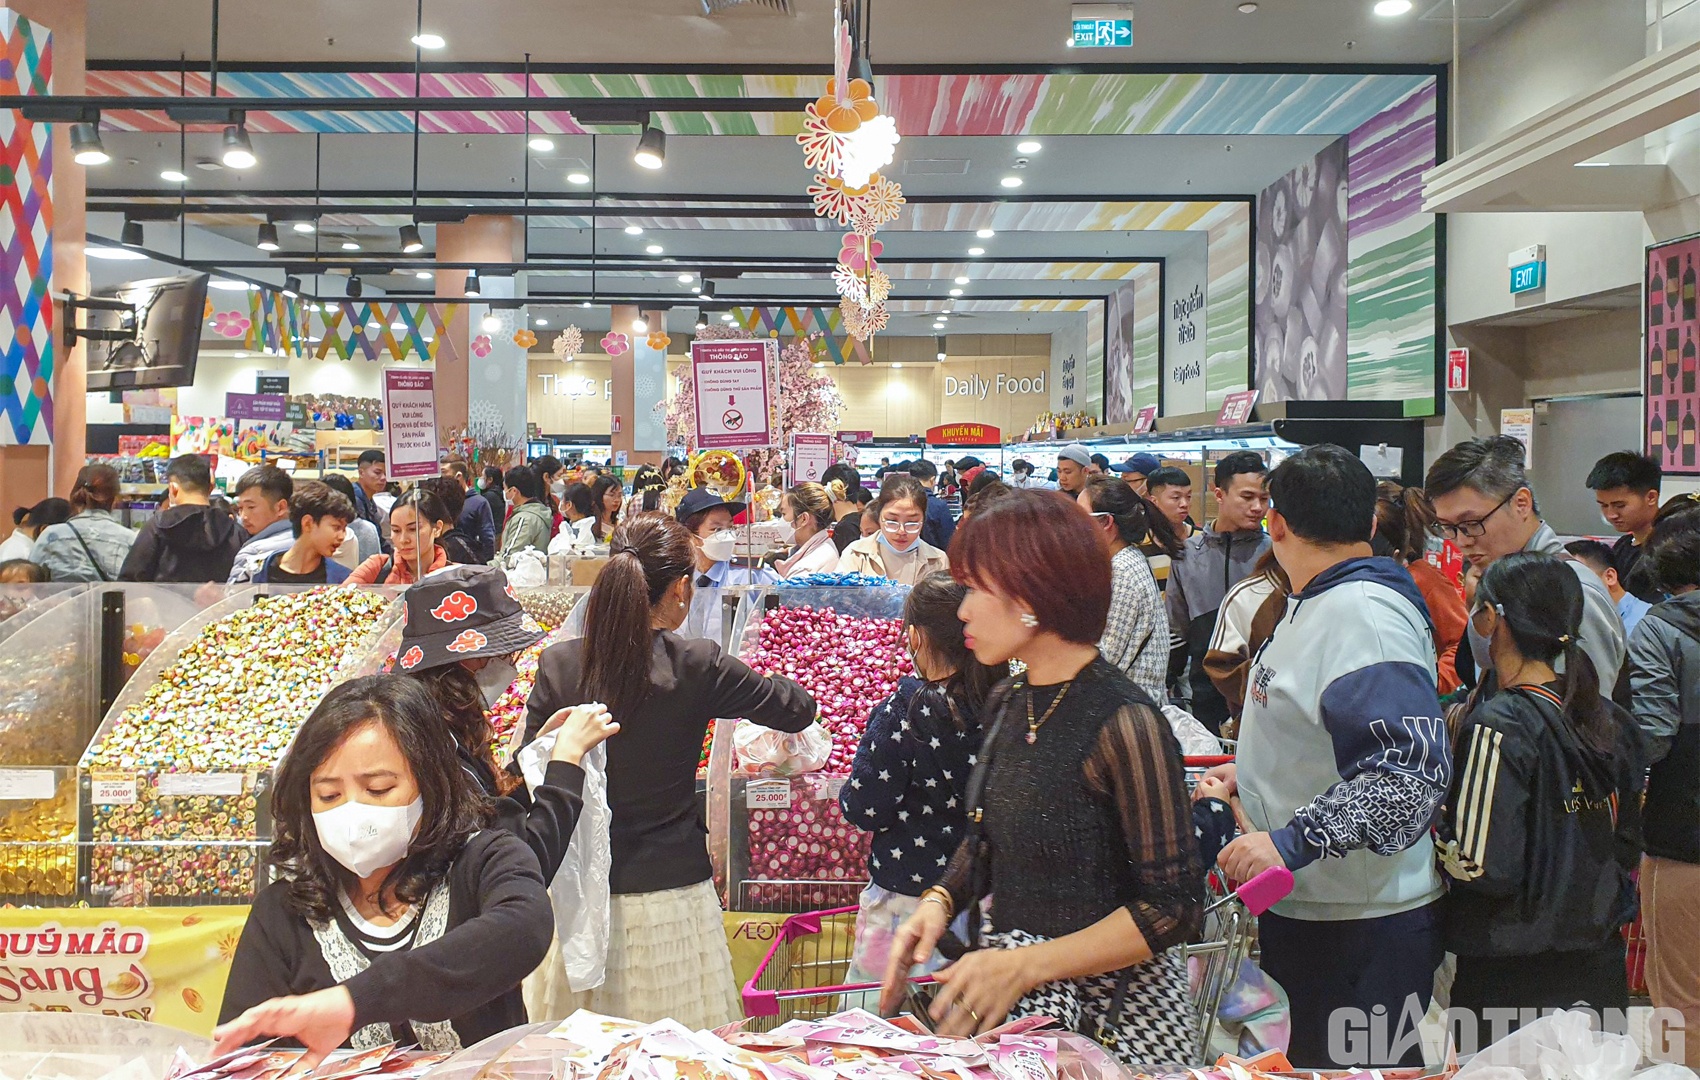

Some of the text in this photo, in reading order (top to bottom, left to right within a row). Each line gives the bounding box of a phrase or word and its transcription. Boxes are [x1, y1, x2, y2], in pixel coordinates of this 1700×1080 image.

[1075, 32, 1094, 41] EXIT
[1515, 267, 1534, 288] EXIT
[397, 380, 424, 388] THÔNG BÁO
[945, 373, 990, 401] Daily
[996, 370, 1046, 394] Food
[402, 401, 418, 409] KHÁCH
[418, 401, 432, 409] HÀNG
[392, 422, 406, 430] CHỌN
[407, 421, 412, 429] VÀ
[412, 430, 425, 438] PHẨM
[942, 424, 984, 438] KHUYẾN MÃI
[397, 441, 412, 449] TRƯỚC
[65, 927, 144, 954] MÃO
